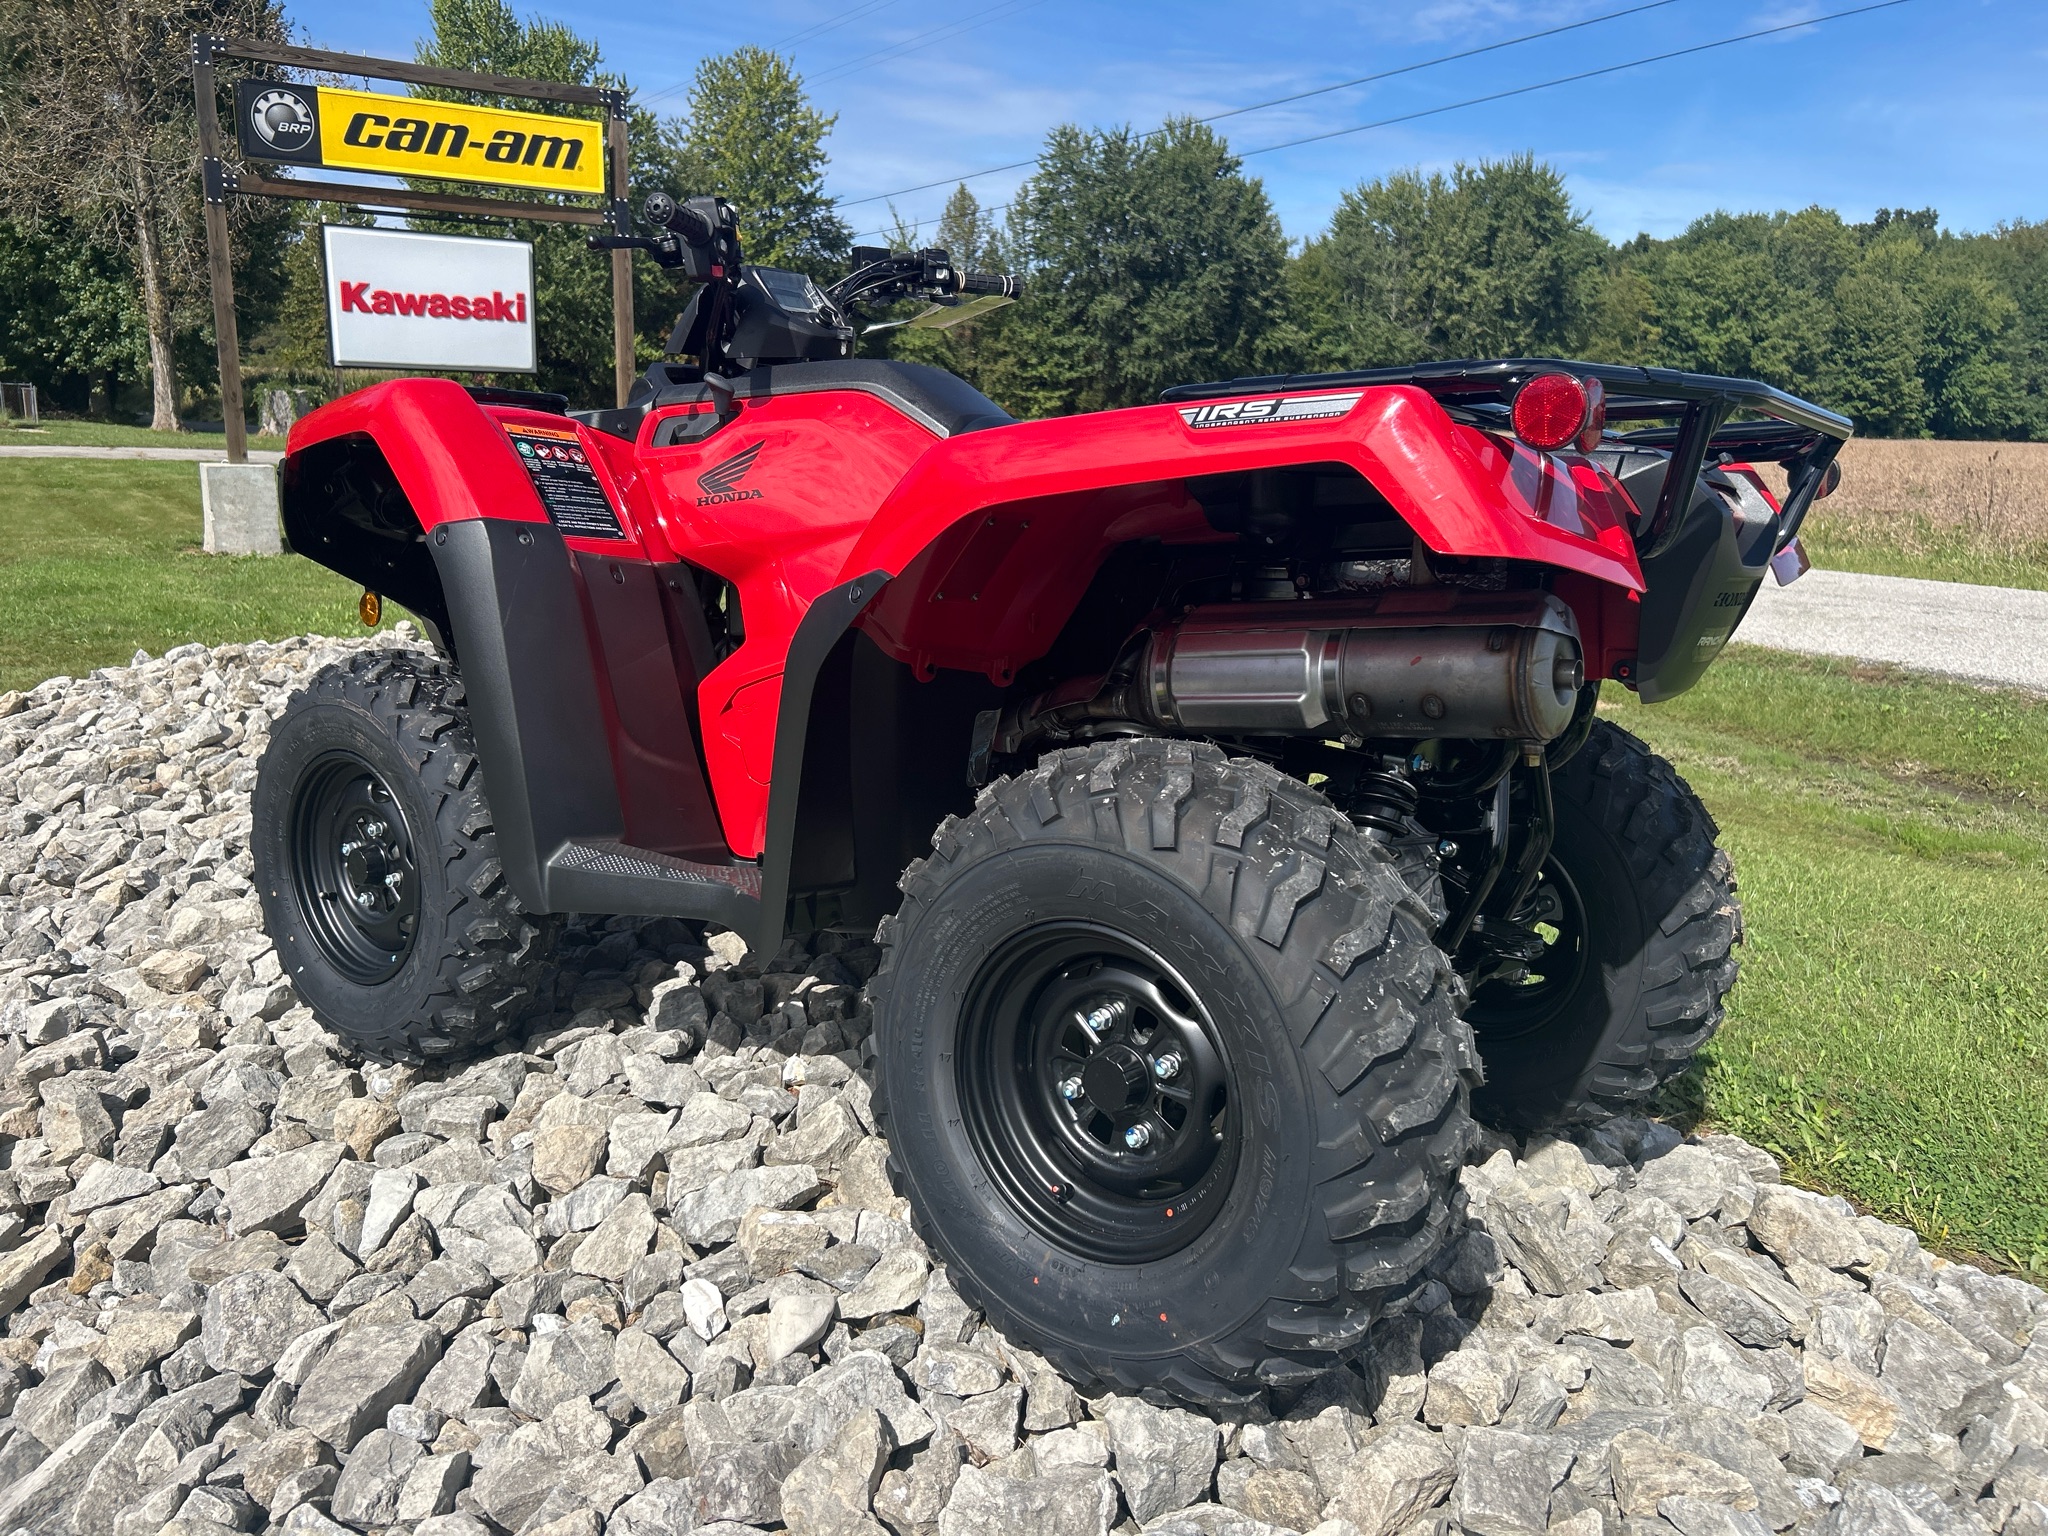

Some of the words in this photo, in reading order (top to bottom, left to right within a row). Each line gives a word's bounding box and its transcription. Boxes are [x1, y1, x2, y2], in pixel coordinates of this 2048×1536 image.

[278, 122, 312, 135] BRP
[343, 112, 585, 170] can-am
[340, 281, 527, 323] Kawasaki
[1195, 400, 1278, 422] IRS
[526, 428, 560, 438] WARNING
[1195, 418, 1256, 429] INDEPENDENT
[696, 488, 765, 507] HONDA
[1065, 871, 1282, 1133] MAXXIS
